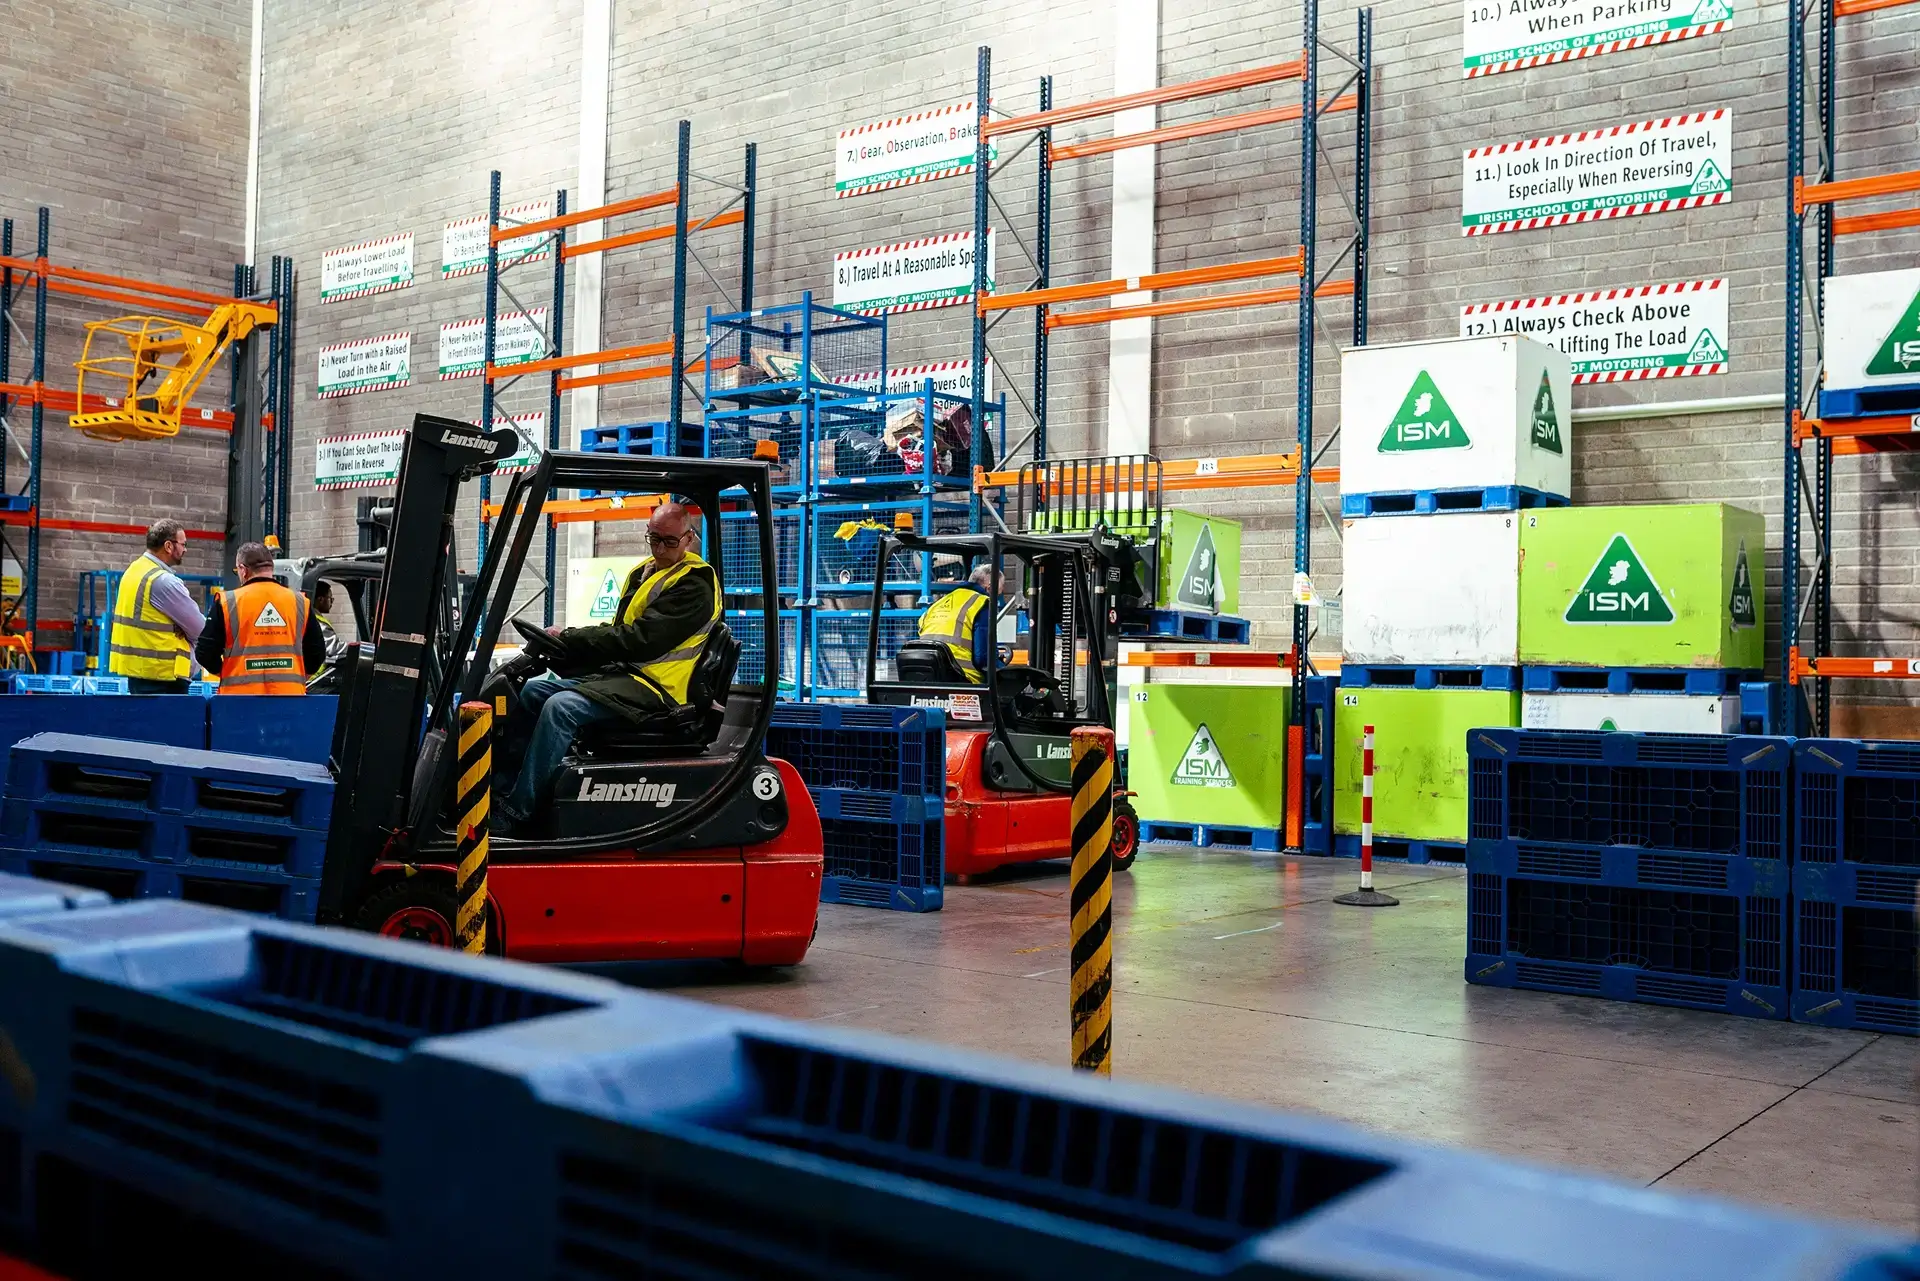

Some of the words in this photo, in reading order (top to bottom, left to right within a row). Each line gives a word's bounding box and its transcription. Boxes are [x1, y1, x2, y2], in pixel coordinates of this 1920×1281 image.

[1472, 5, 1502, 23] 10.)
[1509, 0, 1575, 14] Alway
[1528, 11, 1584, 34] When
[1592, 0, 1672, 21] Parking
[1697, 8, 1724, 21] ISM
[1479, 51, 1514, 65] IRISH
[1518, 40, 1570, 58] SCHOOL
[1573, 36, 1590, 47] OF
[1594, 20, 1669, 44] MOTORING
[847, 150, 858, 163] 7.)
[860, 146, 884, 159] Gear,
[887, 131, 947, 154] Observation,
[1475, 165, 1502, 182] 11.)
[1507, 158, 1540, 177] Look
[1545, 155, 1559, 171] In
[1565, 144, 1634, 168] Direction
[1639, 139, 1657, 157] Of
[1661, 131, 1717, 152] Travel,
[845, 178, 867, 188] IRISH
[869, 172, 900, 186] SCHOOL
[902, 169, 912, 178] OF
[915, 159, 960, 175] MOTORING
[1508, 177, 1574, 201] Especially
[1578, 171, 1617, 189] When
[1623, 160, 1693, 181] Reversing
[1695, 179, 1722, 192] ISM
[1478, 210, 1513, 224] IRISH
[1516, 203, 1568, 219] SCHOOL
[1571, 199, 1589, 211] OF
[1592, 190, 1668, 208] MOTORING
[338, 257, 362, 268] Always
[364, 252, 386, 263] Lower
[388, 246, 405, 257] Load
[338, 270, 361, 282] Before
[364, 262, 399, 276] Travelling
[839, 267, 850, 286] 8.)
[853, 261, 880, 282] Travel
[882, 262, 892, 277] At
[895, 259, 900, 275] A
[904, 250, 956, 274] Reasonable
[959, 248, 975, 264] Spe
[843, 302, 864, 312] IRISH
[866, 297, 898, 308] SCHOOL
[900, 294, 910, 303] OF
[912, 288, 957, 301] MOTORING
[1466, 318, 1497, 336] 12.)
[1503, 313, 1566, 335] Always
[1572, 305, 1625, 327] Check
[1632, 303, 1691, 322] Above
[449, 335, 461, 345] Never
[462, 334, 471, 343] Park
[472, 332, 478, 340] On
[1501, 342, 1508, 352] 7
[1560, 335, 1609, 355] Lifting
[1615, 331, 1643, 349] The
[1649, 326, 1687, 346] Load
[331, 355, 348, 365] Never
[350, 352, 363, 362] Turn
[365, 348, 378, 359] with
[386, 343, 407, 355] Raised
[453, 348, 463, 358] Front
[510, 339, 530, 349] Walkways
[1691, 350, 1719, 362] ISM
[1894, 340, 1920, 362] IS
[338, 367, 354, 378] Load
[357, 365, 364, 375] in
[366, 362, 378, 374] the
[380, 361, 391, 371] Air
[462, 361, 482, 369] SCHOOL
[1571, 361, 1586, 374] OF
[1589, 357, 1665, 372] MOTORING
[364, 376, 388, 385] MOTORING
[886, 380, 910, 395] orklift
[913, 378, 956, 392] Tuovers
[1397, 420, 1450, 442] ISM
[327, 449, 330, 458] If
[332, 448, 341, 457] You
[343, 447, 354, 456] Cant
[356, 445, 365, 455] See
[367, 444, 379, 454] Over
[381, 442, 390, 452] The
[441, 429, 498, 454] Lansing
[336, 459, 353, 470] Travel
[355, 460, 360, 469] In
[362, 458, 384, 468] Reverse
[1505, 519, 1511, 528] 8
[1530, 518, 1536, 527] 2
[1101, 536, 1119, 548] Lansing
[598, 597, 620, 610] ISM
[1589, 592, 1649, 612] ISM
[1733, 595, 1750, 614] ISM
[911, 695, 951, 712] Lansing
[1136, 692, 1147, 701] 12
[1345, 695, 1357, 705] 14
[1708, 703, 1715, 714] 4
[1047, 743, 1072, 758] Lansi
[1186, 759, 1221, 776] ISM
[760, 778, 772, 796] 3
[1205, 779, 1233, 787] SERVICES
[577, 777, 677, 808] Lansing
